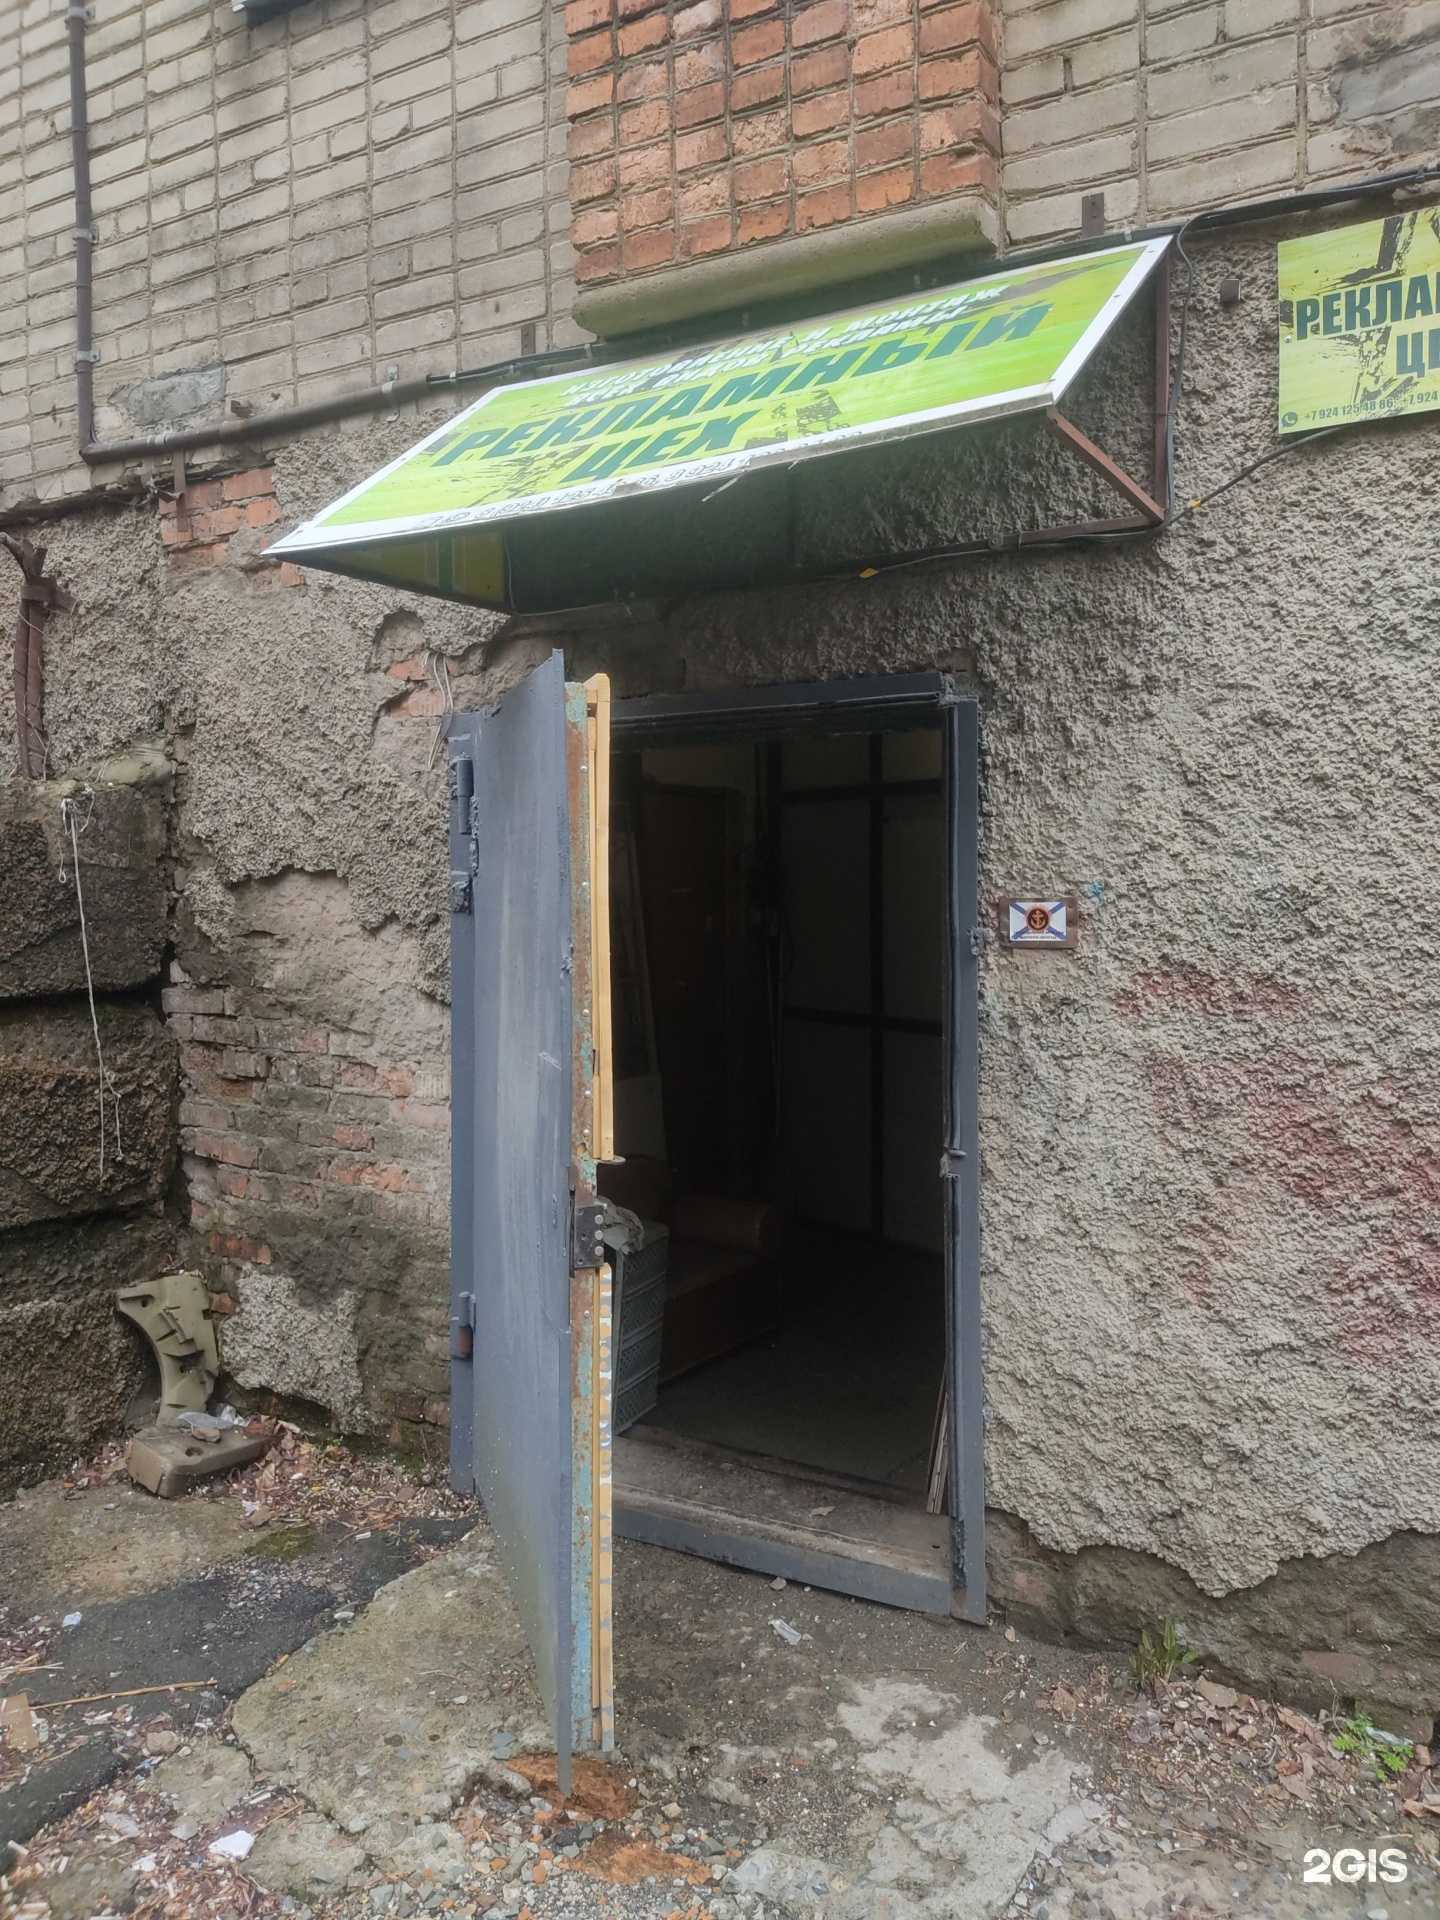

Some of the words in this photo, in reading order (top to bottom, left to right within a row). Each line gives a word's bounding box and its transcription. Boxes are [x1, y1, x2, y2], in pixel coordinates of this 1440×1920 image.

[1296, 271, 1440, 341] РЕКЛА
[431, 301, 1054, 467] РЕКЛАМНЫЙ
[1319, 406, 1338, 419] 924
[1417, 391, 1438, 403] 924
[559, 408, 761, 481] ЦЕХ
